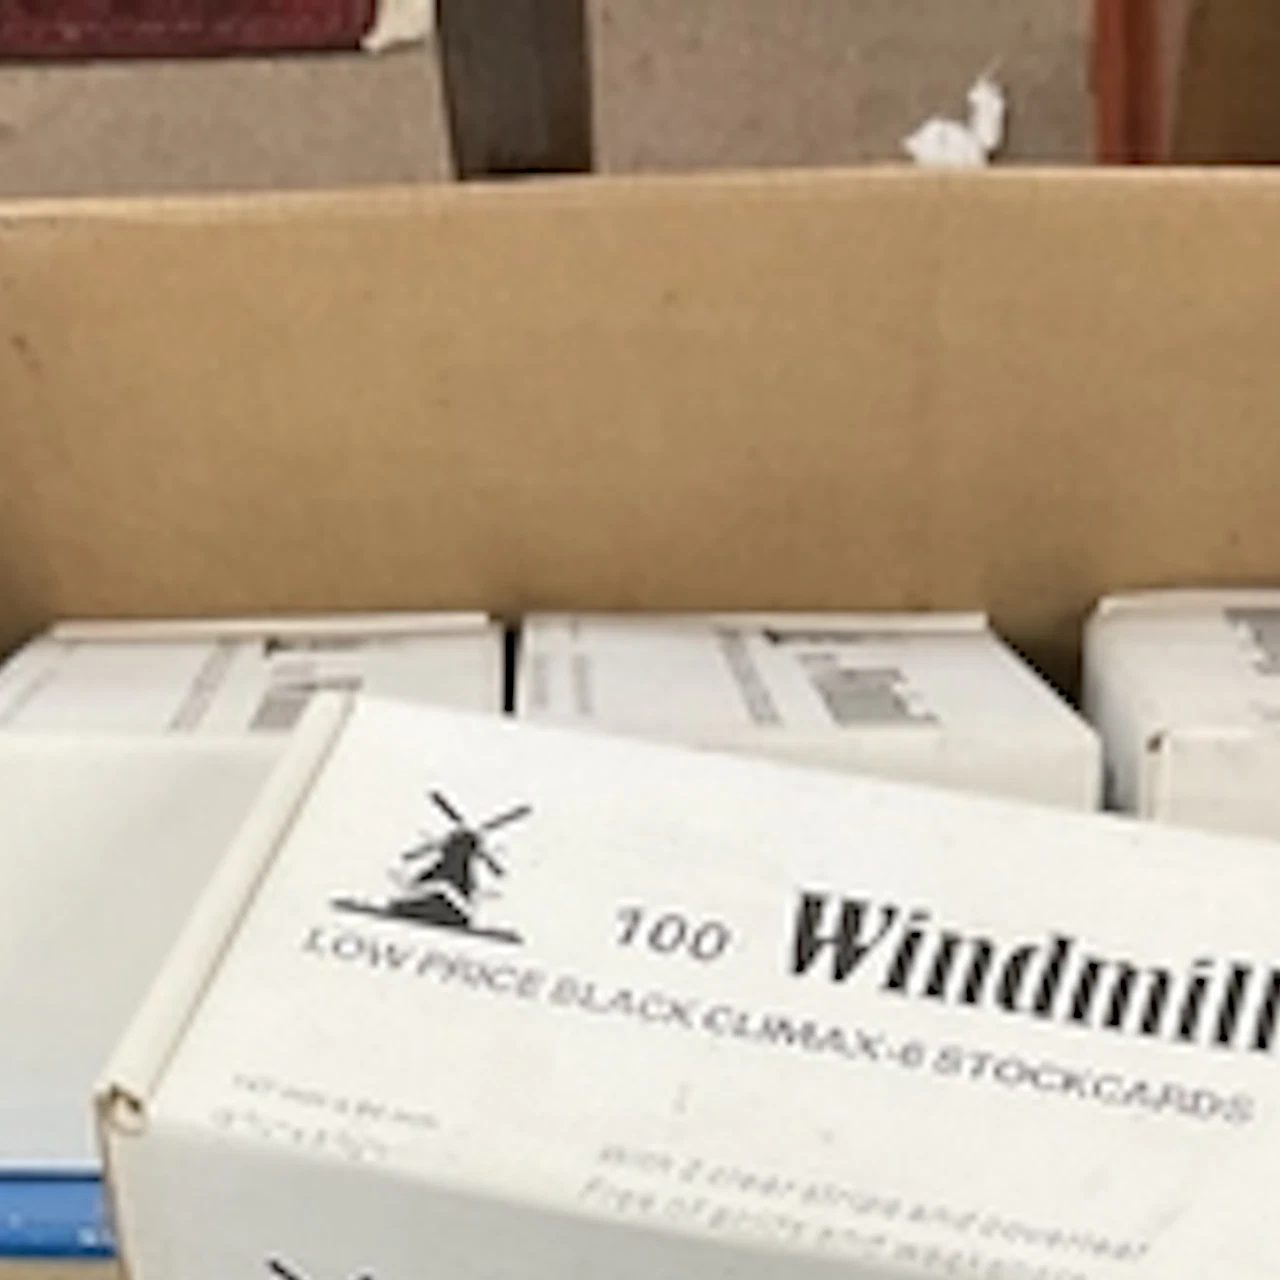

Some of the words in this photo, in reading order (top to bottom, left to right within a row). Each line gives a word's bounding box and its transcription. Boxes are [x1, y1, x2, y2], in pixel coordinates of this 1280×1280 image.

[616, 904, 734, 964] 100
[302, 926, 413, 972] LOW
[417, 945, 547, 1001] PRICE
[549, 974, 694, 1032] BLACK
[701, 1003, 924, 1068] CLIMAX-6
[931, 1044, 1256, 1126] STOCKCARDS
